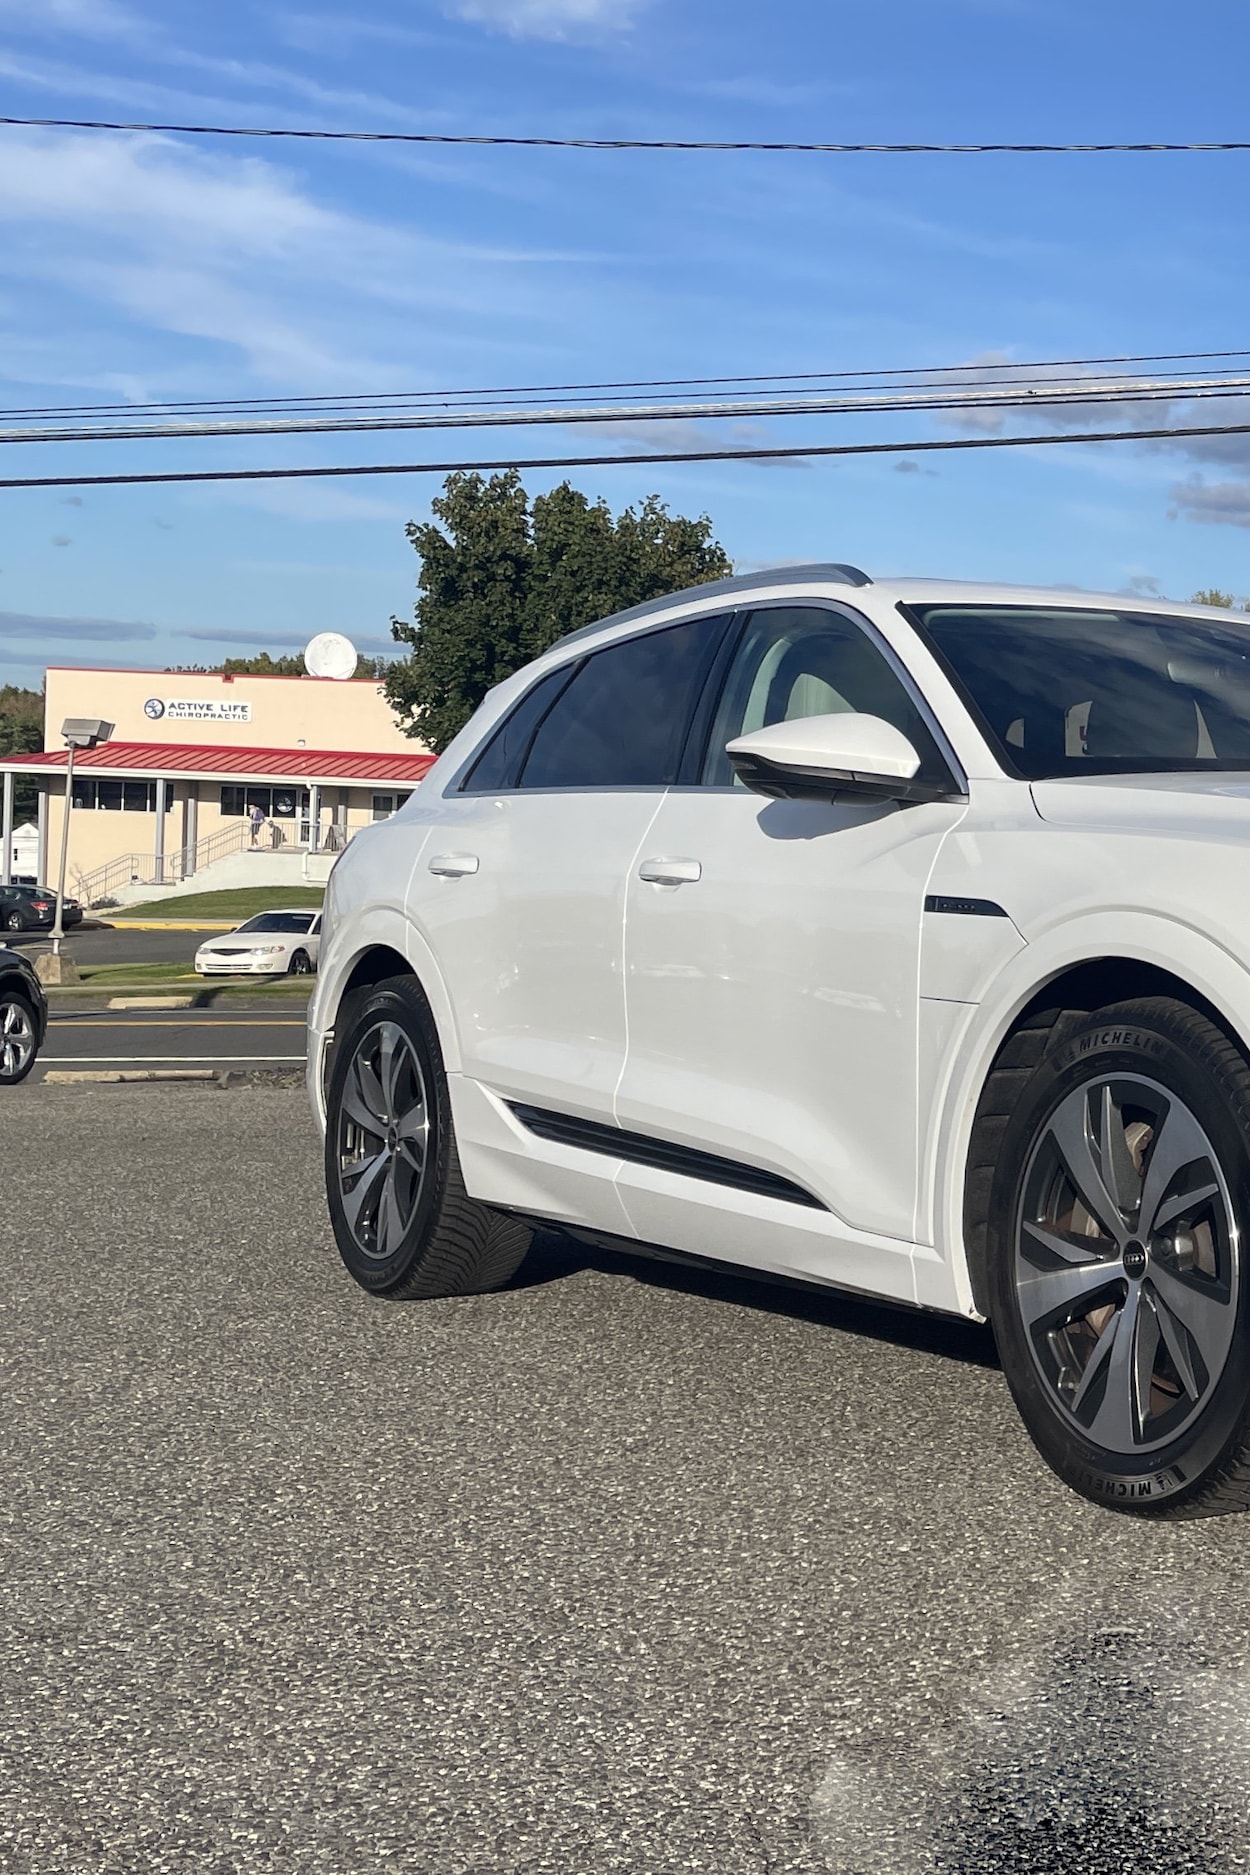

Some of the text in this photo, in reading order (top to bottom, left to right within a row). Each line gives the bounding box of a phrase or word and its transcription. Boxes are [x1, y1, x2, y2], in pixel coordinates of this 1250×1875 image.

[168, 702, 249, 713] ACTIVE LIFE
[168, 711, 248, 720] CHIROPRACTIC
[1079, 1031, 1165, 1054] MICHELIN
